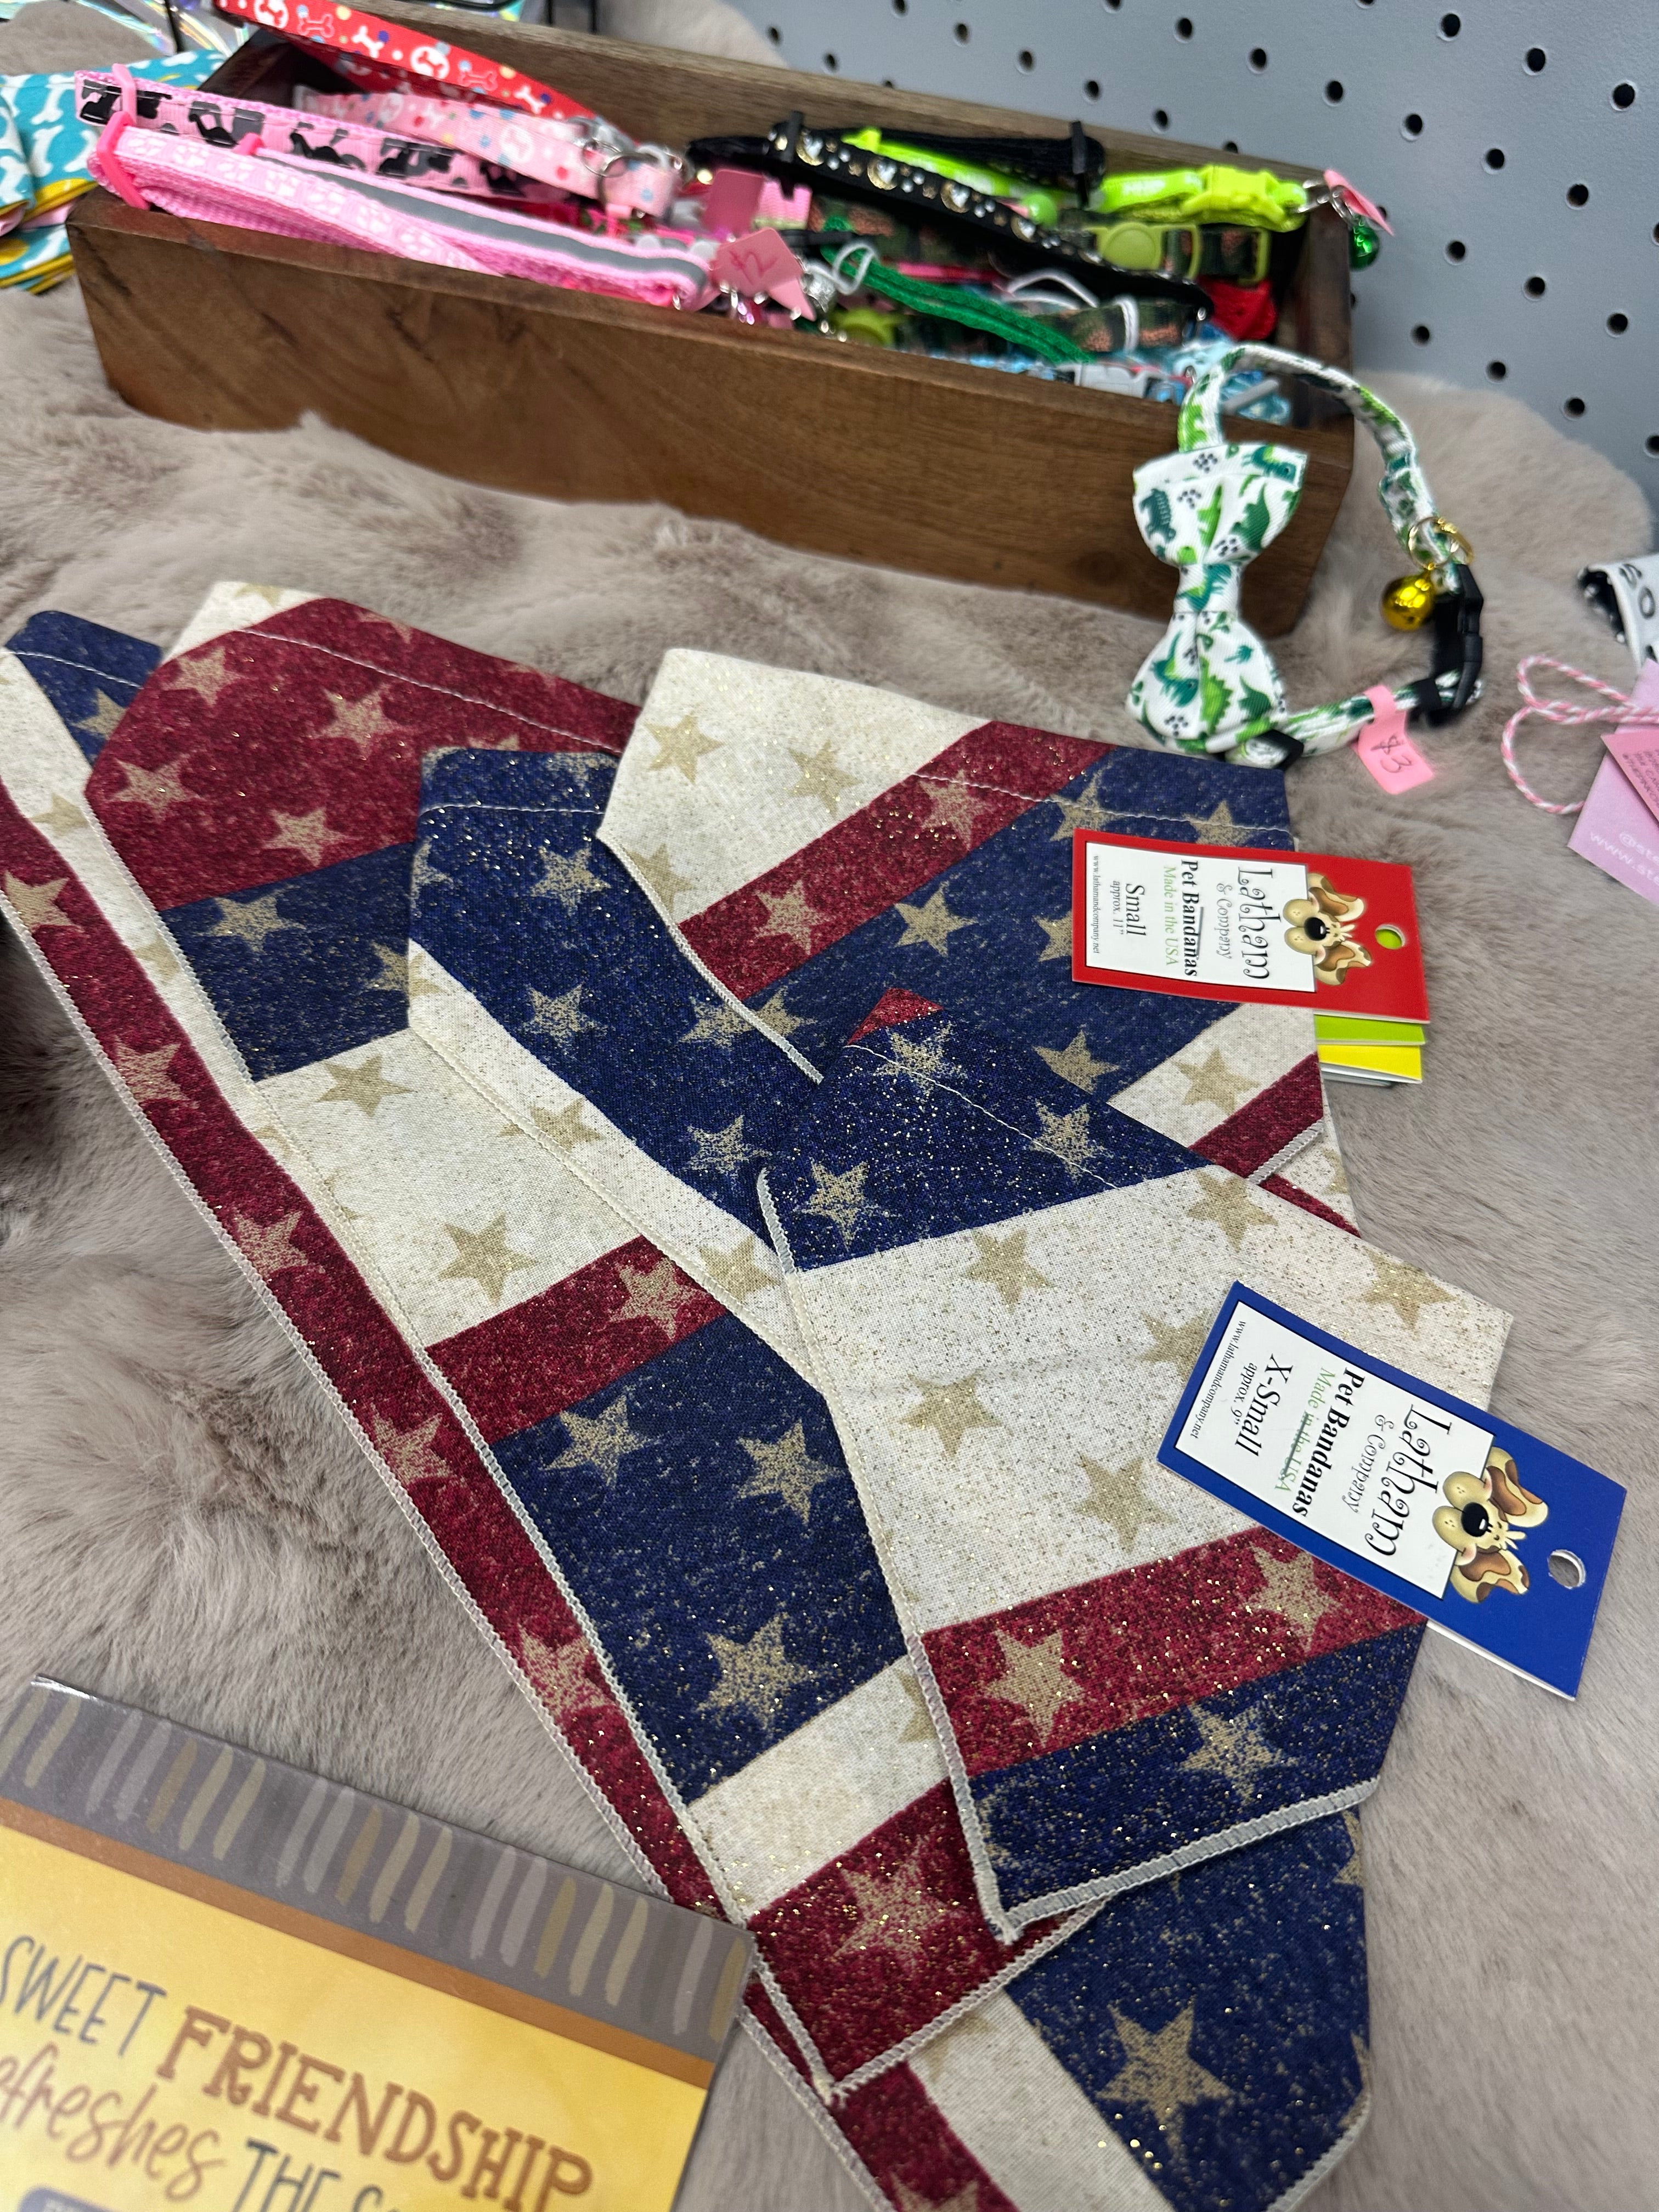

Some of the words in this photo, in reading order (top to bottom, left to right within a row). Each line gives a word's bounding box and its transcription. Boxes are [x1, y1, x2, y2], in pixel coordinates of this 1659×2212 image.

[1370, 735, 1413, 774] $3
[1164, 866, 1177, 898] Made
[1181, 860, 1198, 887] Pet
[1216, 883, 1233, 895] &
[1091, 855, 1101, 954] www.lathamandcompany.net
[1110, 880, 1121, 915] approx.
[1125, 883, 1147, 936] Small
[1164, 901, 1177, 913] in
[1165, 916, 1178, 934] the
[1182, 892, 1200, 977] Bandanas
[1214, 899, 1232, 960] Company
[1238, 867, 1282, 979] Latham
[1165, 938, 1179, 966] USA
[1190, 1321, 1246, 1439] www.lathamandcompany.net
[1233, 1362, 1257, 1403] approx.
[1308, 1367, 1336, 1409] Made
[1334, 1367, 1365, 1407] Pet
[1235, 1353, 1294, 1457] X-Small
[1300, 1410, 1320, 1427] in
[1374, 1414, 1395, 1431] &
[1291, 1429, 1311, 1453] the
[1274, 1457, 1302, 1492] USA
[1292, 1406, 1351, 1517] Bandanas
[1341, 1434, 1386, 1513] Company
[1364, 1404, 1452, 1556] Latham
[0, 1934, 167, 2058] SWEET
[155, 2004, 594, 2212] FRIENDSHIP
